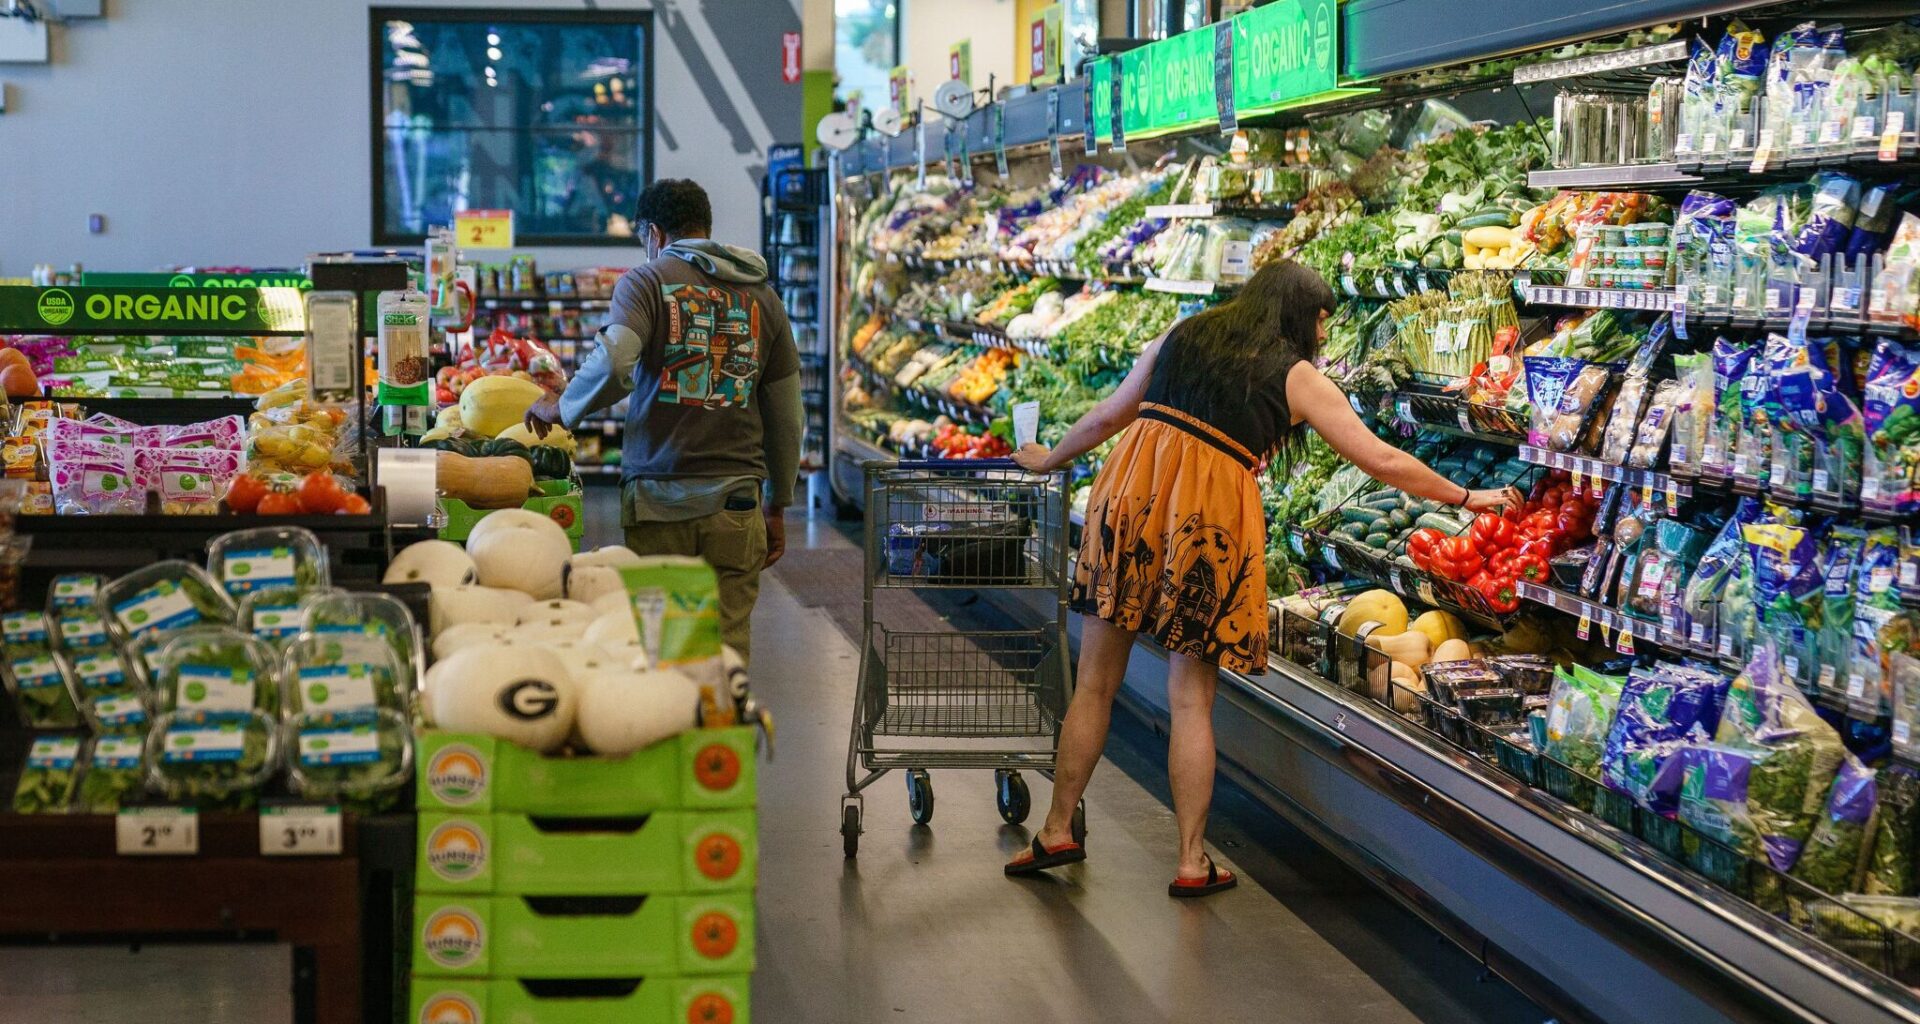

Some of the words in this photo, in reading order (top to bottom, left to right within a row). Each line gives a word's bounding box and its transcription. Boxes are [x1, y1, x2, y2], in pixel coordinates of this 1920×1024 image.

[1252, 19, 1311, 80] ORGANIC
[1166, 50, 1214, 101] ORGANIC
[46, 297, 66, 306] USDA
[85, 294, 247, 321] ORGANIC
[384, 315, 415, 324] Sticks
[504, 682, 558, 717] G
